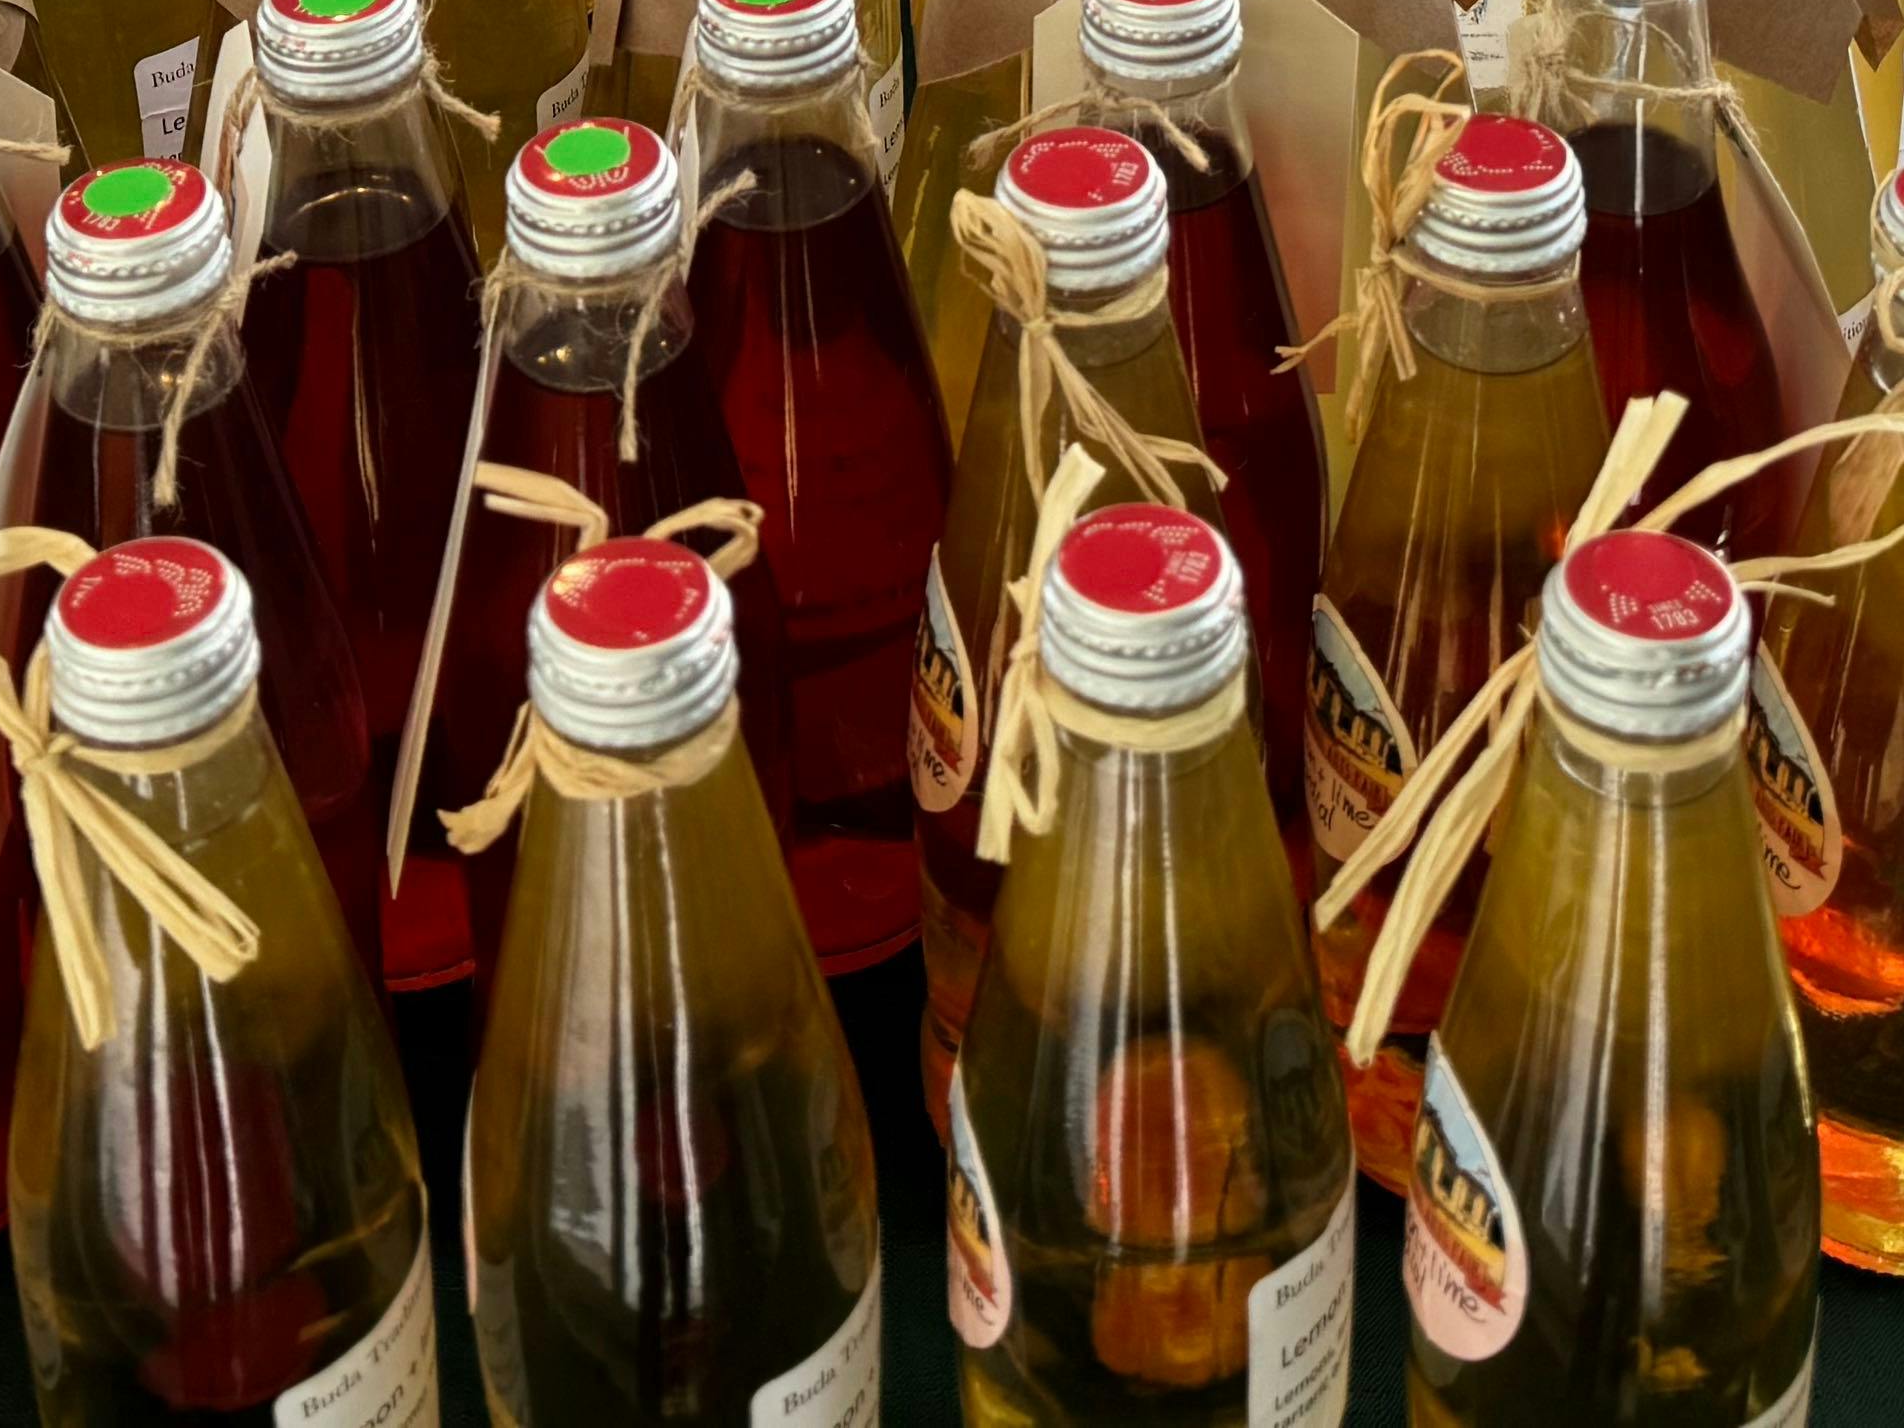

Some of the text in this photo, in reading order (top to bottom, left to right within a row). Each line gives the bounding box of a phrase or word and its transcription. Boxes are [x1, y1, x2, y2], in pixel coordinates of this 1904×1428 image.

[152, 61, 194, 87] Buda
[162, 115, 187, 135] Le
[552, 90, 580, 118] Buda
[1276, 1260, 1324, 1310] Buda
[1281, 1279, 1348, 1370] Lemon
[301, 1370, 363, 1418] Buda
[784, 1367, 836, 1416] Buda
